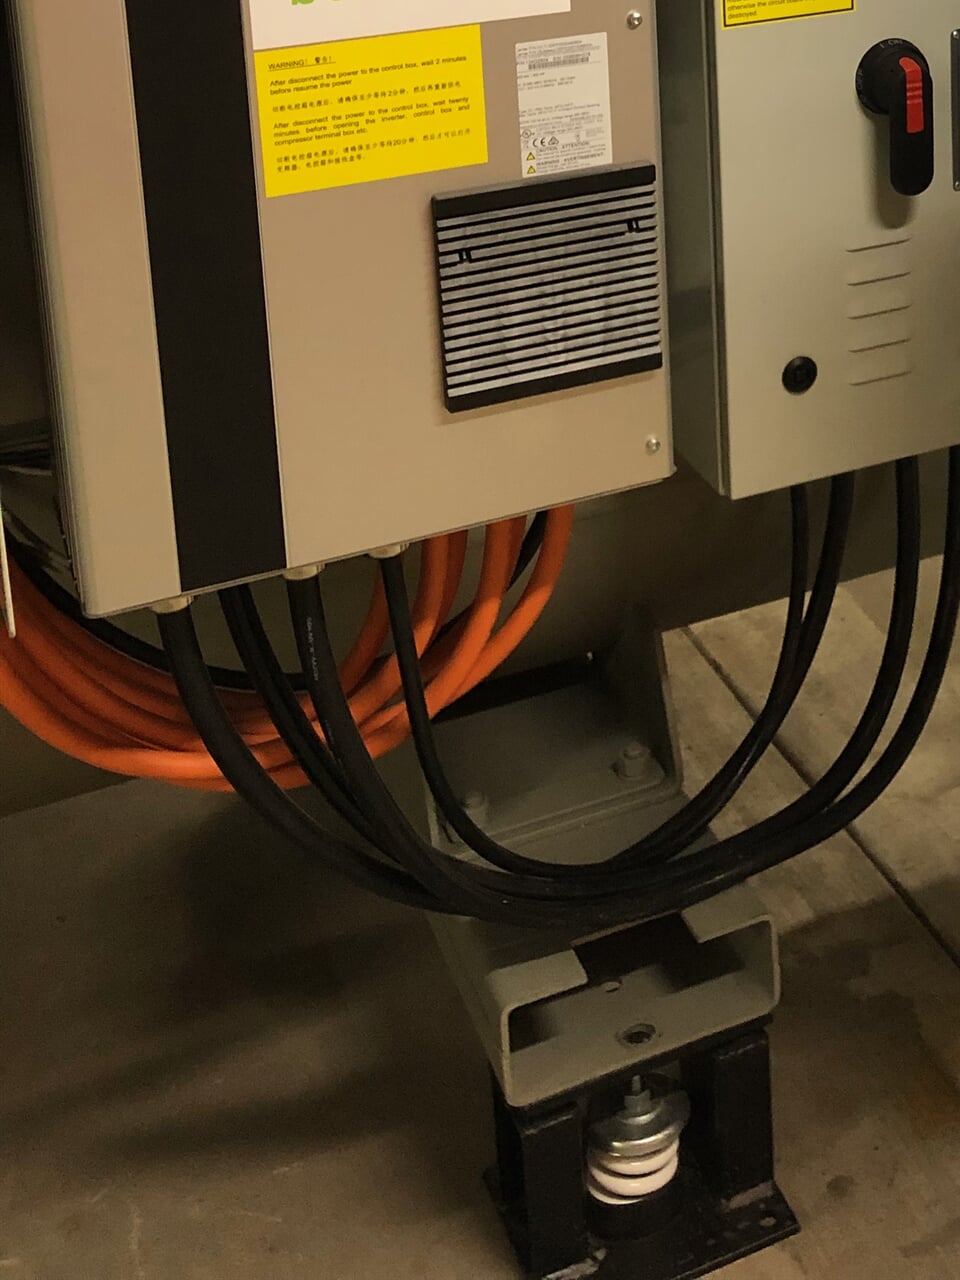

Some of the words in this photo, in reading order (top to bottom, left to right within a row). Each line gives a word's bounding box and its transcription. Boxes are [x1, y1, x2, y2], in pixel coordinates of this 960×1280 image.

[288, 75, 324, 85] disconnect
[338, 71, 359, 79] power
[381, 64, 403, 72] control
[442, 55, 466, 63] minutes
[270, 87, 291, 95] before
[332, 80, 352, 88] power
[273, 122, 289, 130] After
[292, 117, 328, 127] disconnect
[345, 112, 365, 120] power
[391, 104, 413, 112] control
[449, 96, 469, 105] twenty
[273, 129, 300, 138] minutes
[306, 125, 327, 133] before
[333, 121, 359, 131] opening
[413, 109, 435, 117] control
[274, 137, 313, 148] compressor
[315, 132, 341, 140] terminal
